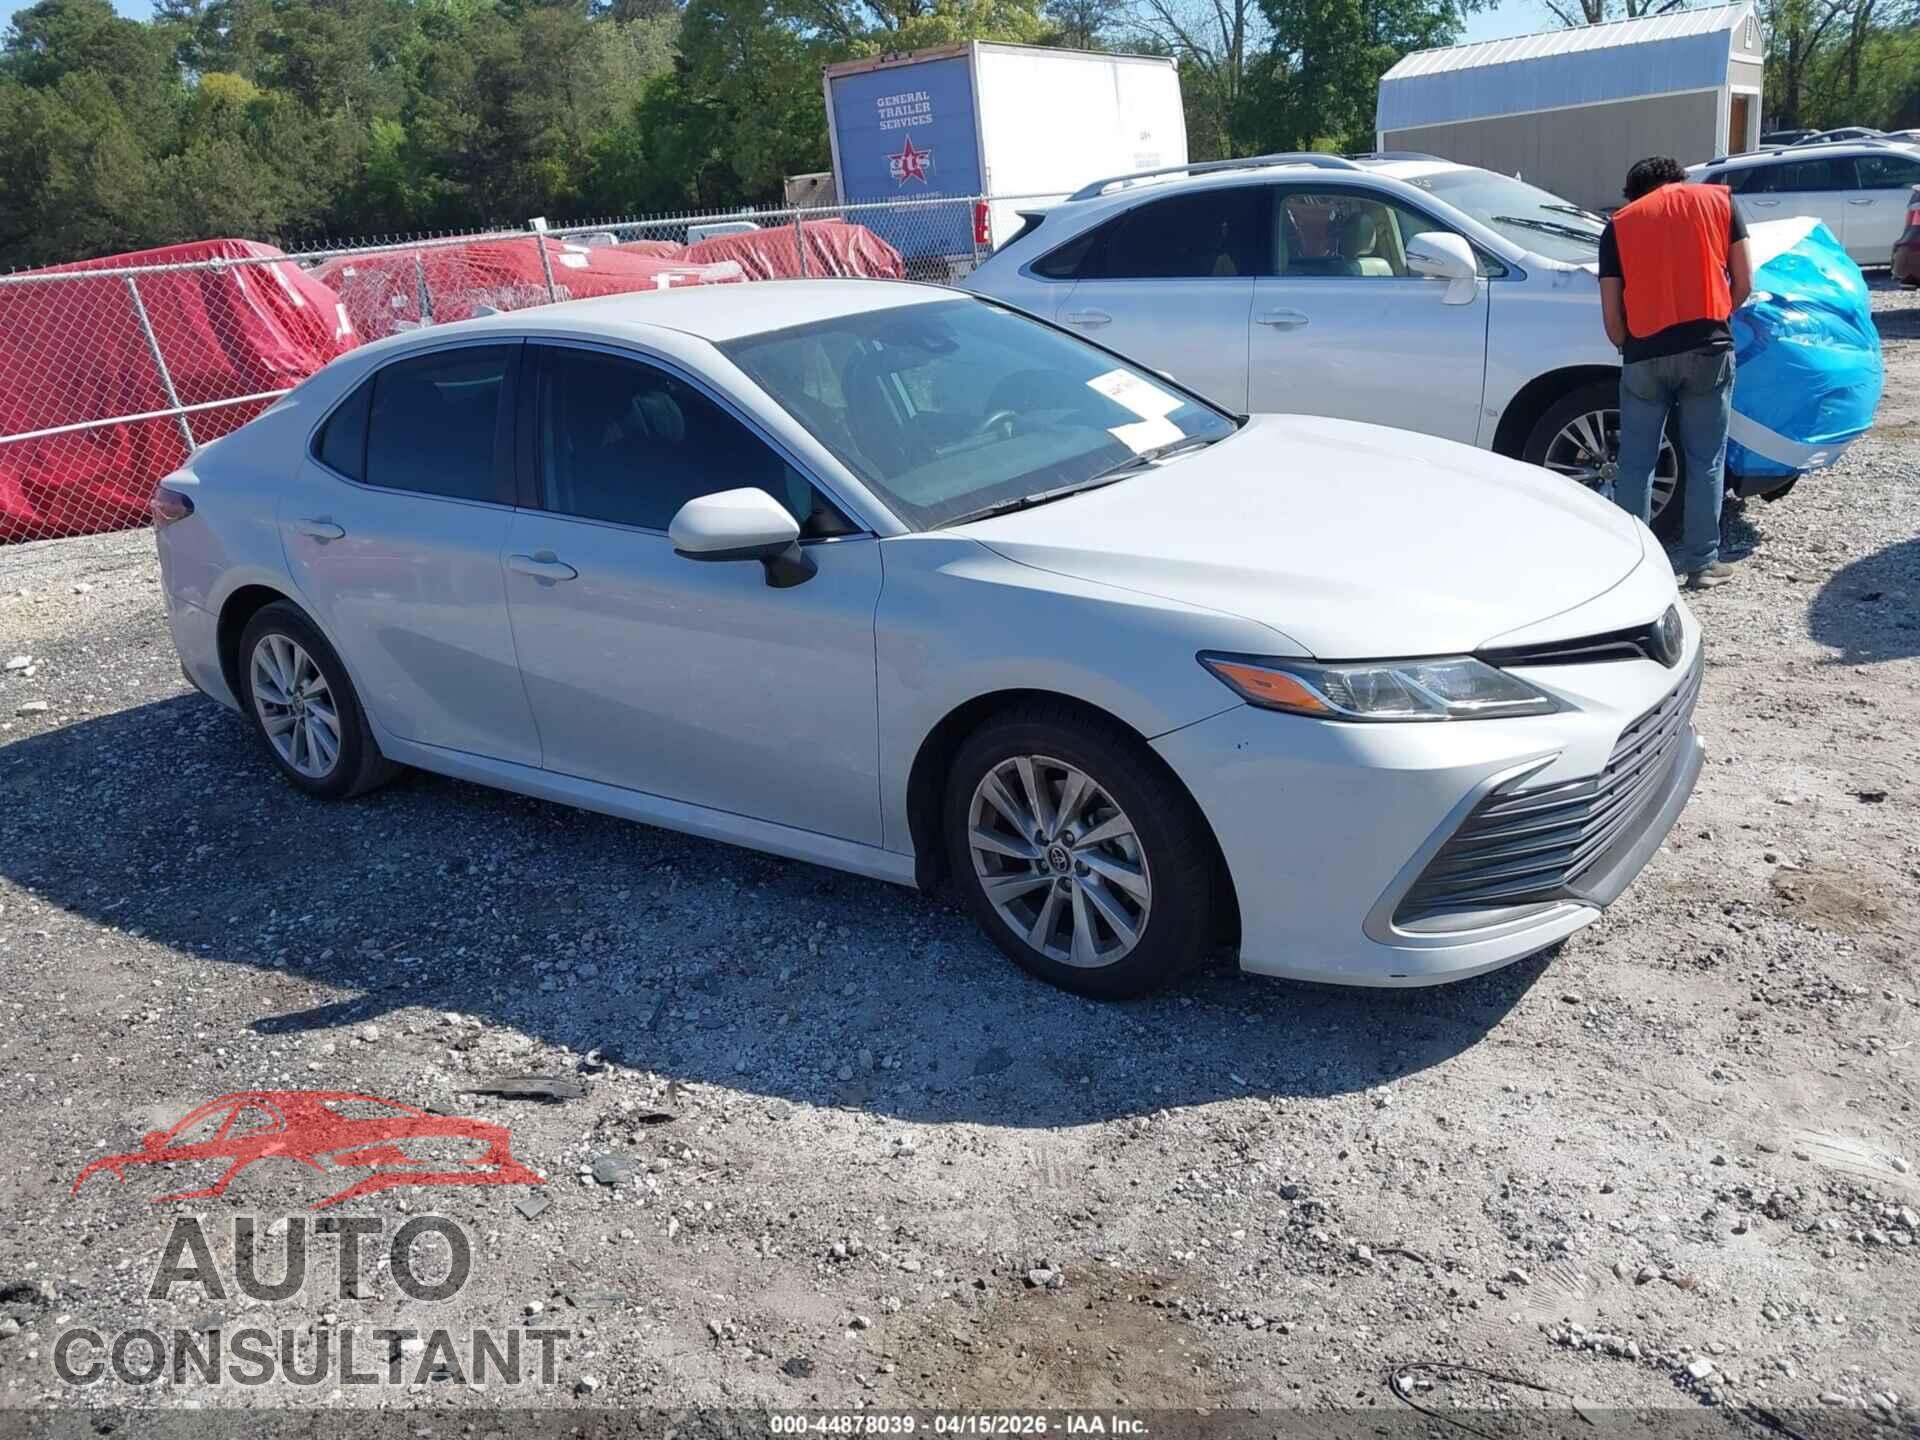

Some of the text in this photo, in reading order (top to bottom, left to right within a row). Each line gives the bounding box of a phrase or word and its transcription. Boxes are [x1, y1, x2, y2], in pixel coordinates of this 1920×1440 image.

[877, 91, 930, 107] GENERAL
[878, 102, 931, 118] TRAILER
[880, 114, 933, 130] SERVICES
[890, 153, 930, 178] gts
